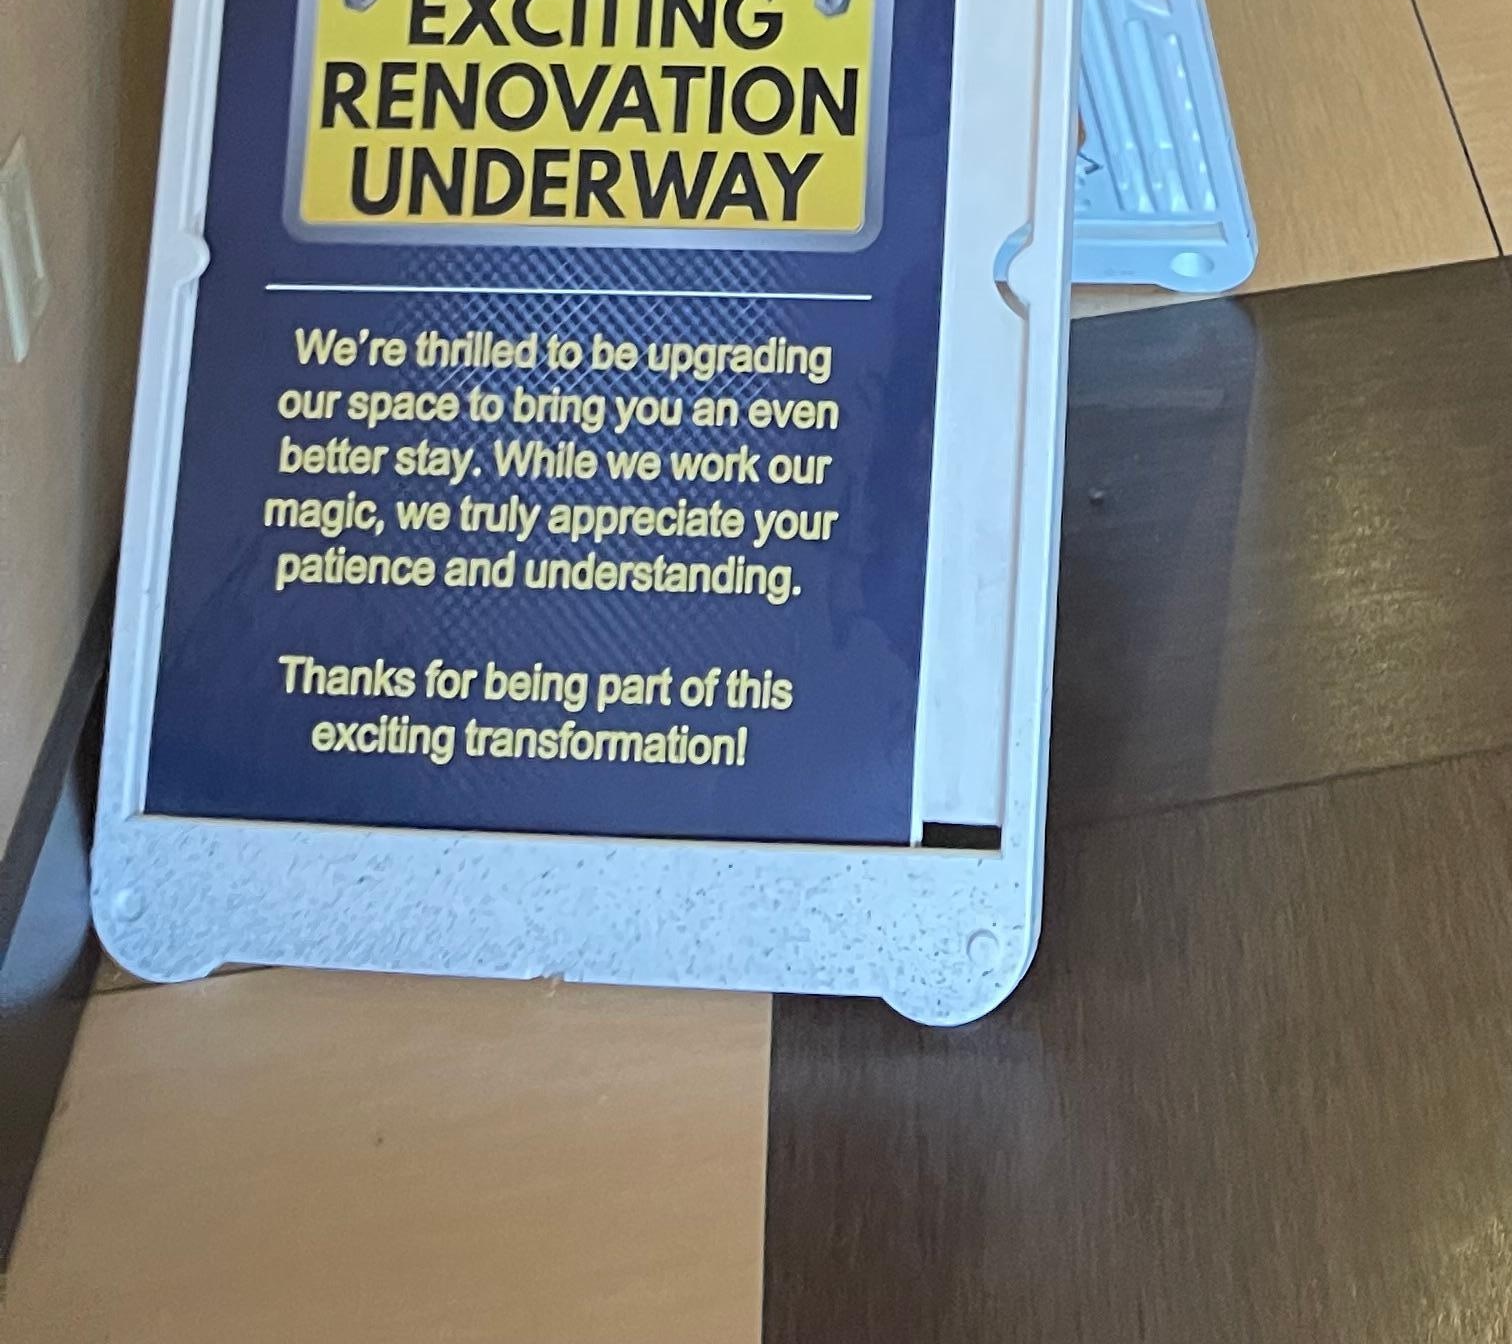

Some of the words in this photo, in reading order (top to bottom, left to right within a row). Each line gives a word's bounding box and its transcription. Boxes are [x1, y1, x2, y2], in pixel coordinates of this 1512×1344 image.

[320, 61, 859, 137] RENOVATION
[351, 145, 823, 222] UNDERWAY
[295, 328, 407, 366] We're
[415, 331, 537, 368] thrilled
[547, 337, 582, 369] to
[592, 336, 637, 369] be
[647, 339, 832, 384] upgrading
[278, 389, 341, 419] our
[347, 391, 460, 428] space
[469, 390, 502, 421] to
[513, 388, 605, 432] bring
[615, 397, 681, 432] you
[693, 398, 738, 426] an
[748, 400, 838, 428] even
[279, 437, 387, 474] better
[395, 441, 480, 484] stay.
[494, 442, 597, 478] While
[607, 453, 660, 480] we
[671, 447, 757, 481] work
[768, 454, 829, 484] our
[264, 493, 383, 538] magic,
[396, 501, 450, 530] we
[460, 497, 539, 541] truly
[548, 499, 744, 540] appreciate
[755, 510, 837, 547] your
[275, 546, 436, 589] patience
[444, 553, 515, 588] and
[524, 555, 802, 605] understanding.
[280, 655, 415, 697] Thanks
[426, 660, 476, 699] for
[484, 663, 588, 711] being
[596, 671, 672, 710] part
[680, 668, 720, 705] of
[727, 671, 791, 709] this
[312, 716, 455, 764] exciting
[465, 721, 747, 764] transformation!
